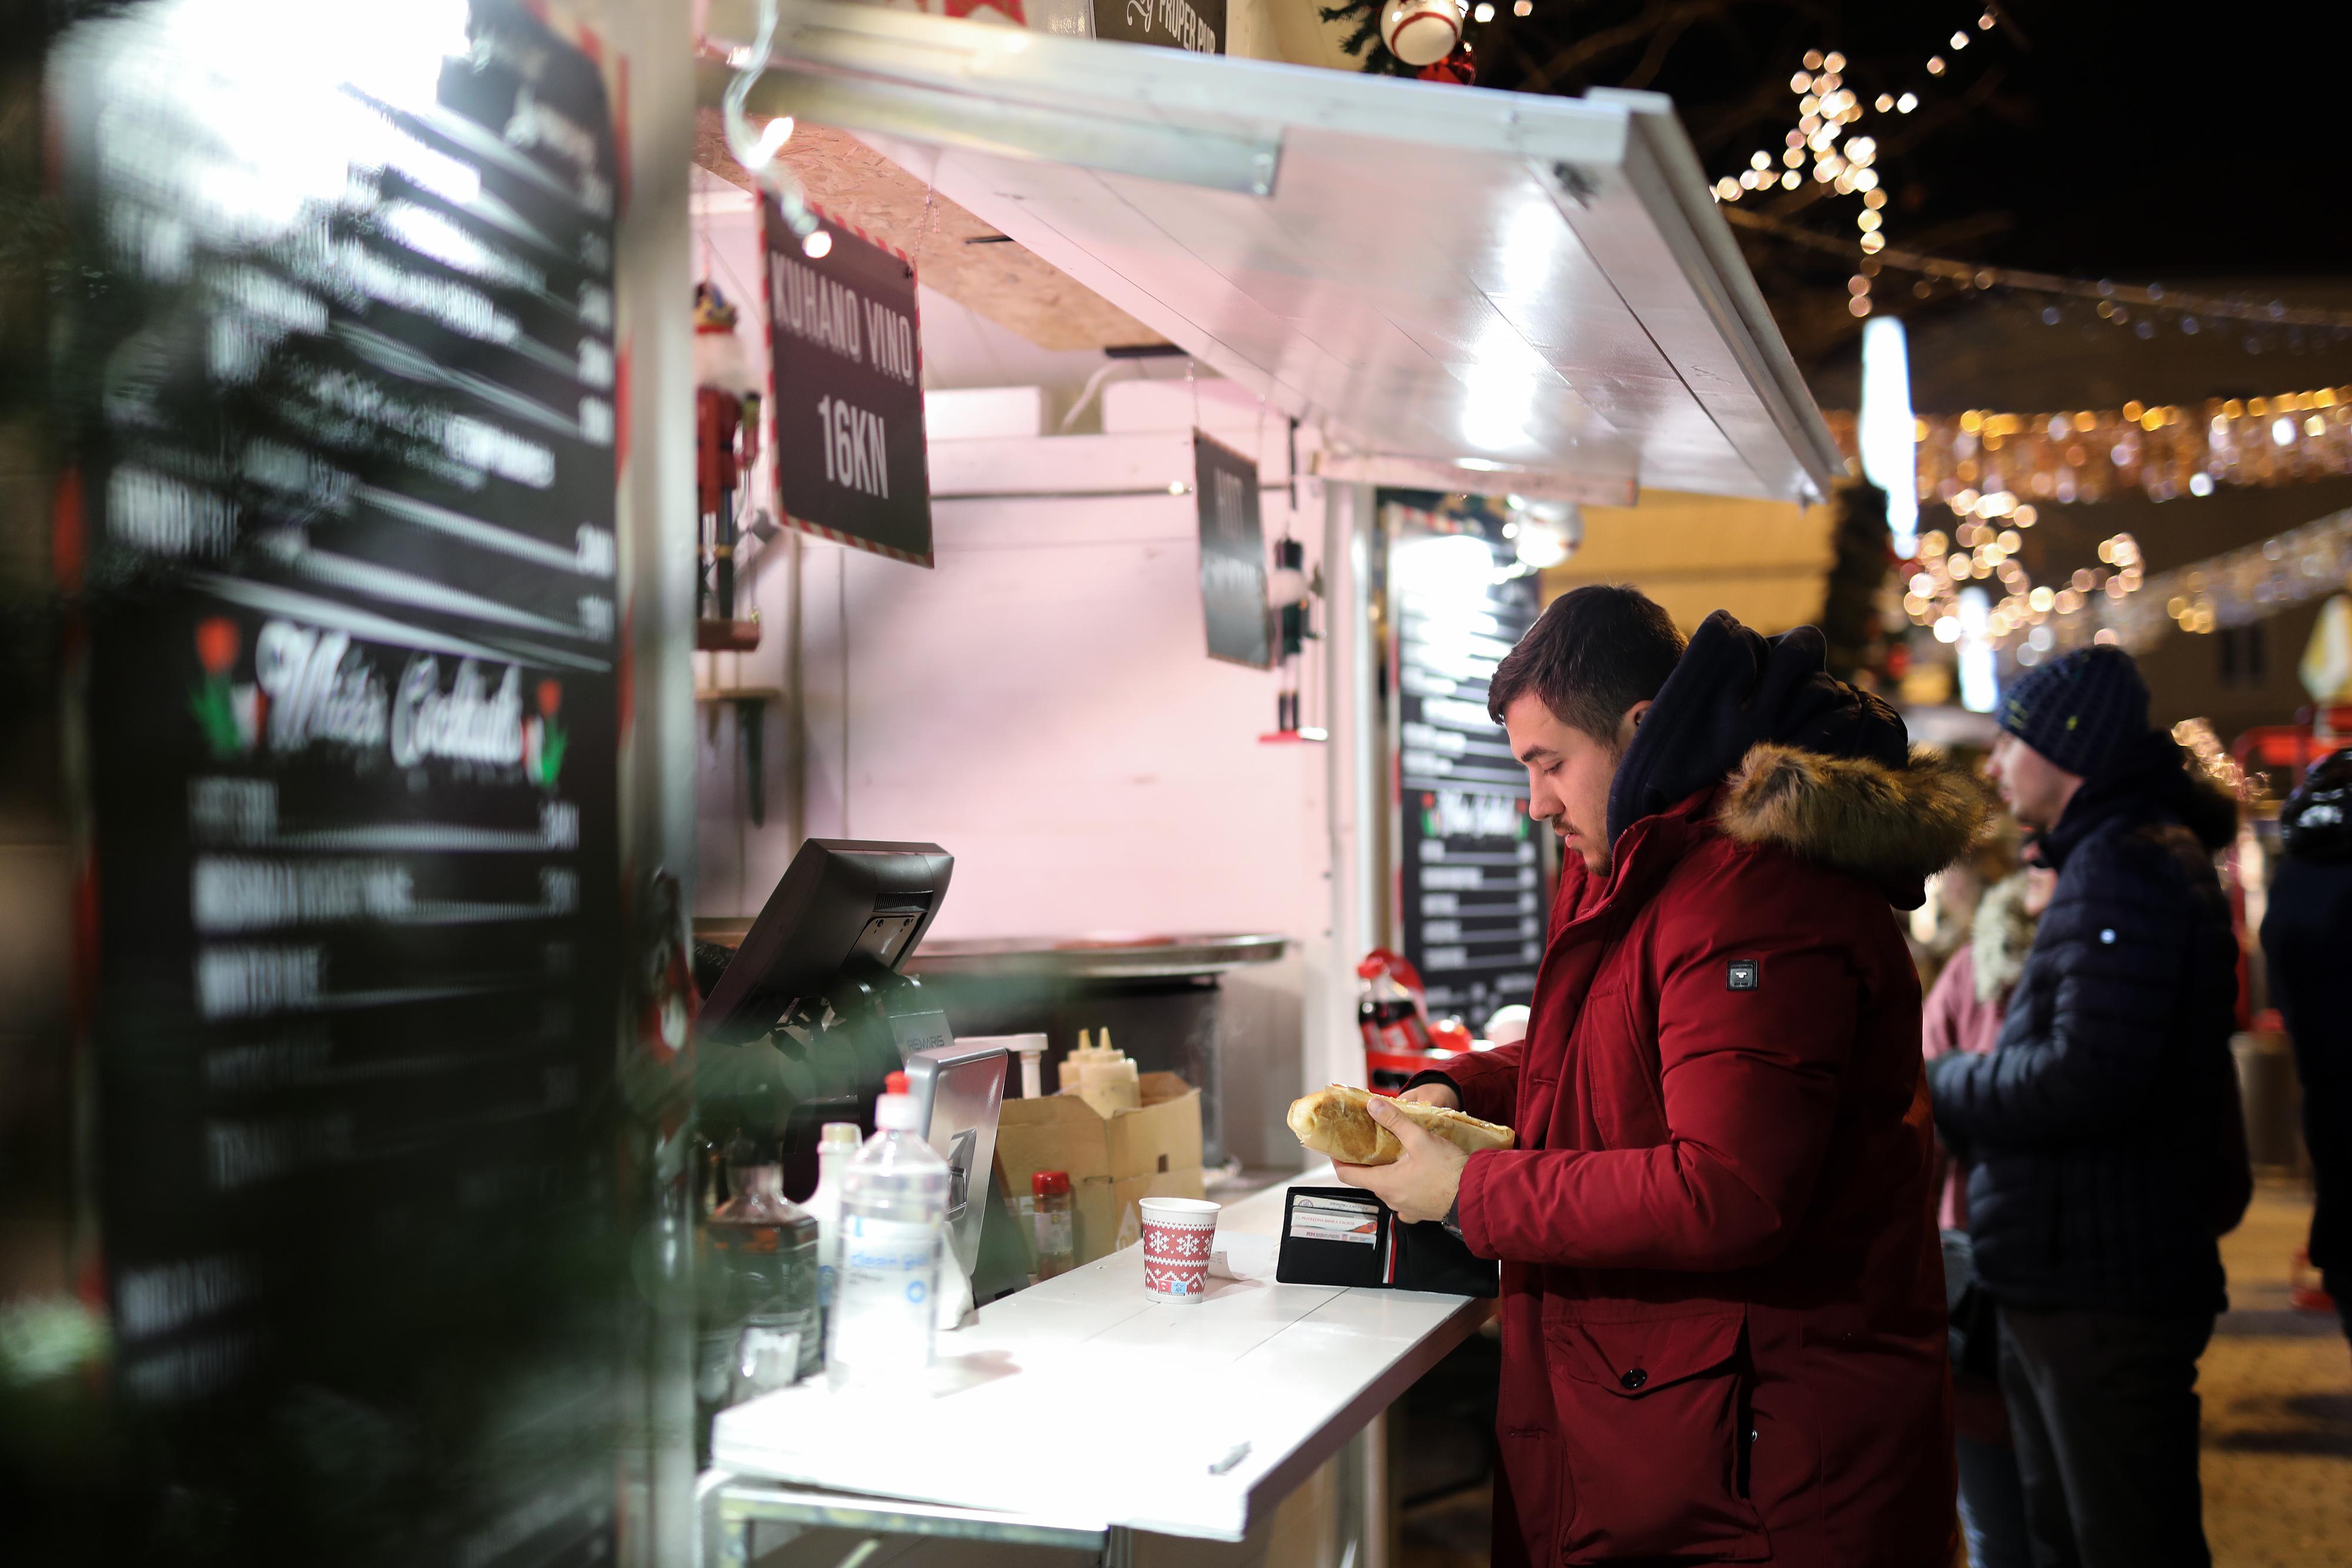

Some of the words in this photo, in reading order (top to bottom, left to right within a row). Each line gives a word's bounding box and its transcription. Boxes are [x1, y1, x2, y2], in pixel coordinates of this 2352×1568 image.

[770, 249, 861, 357] KUHANO
[864, 296, 913, 382] VINO
[817, 394, 888, 499] 16KN
[907, 1035, 945, 1052] REMARIS
